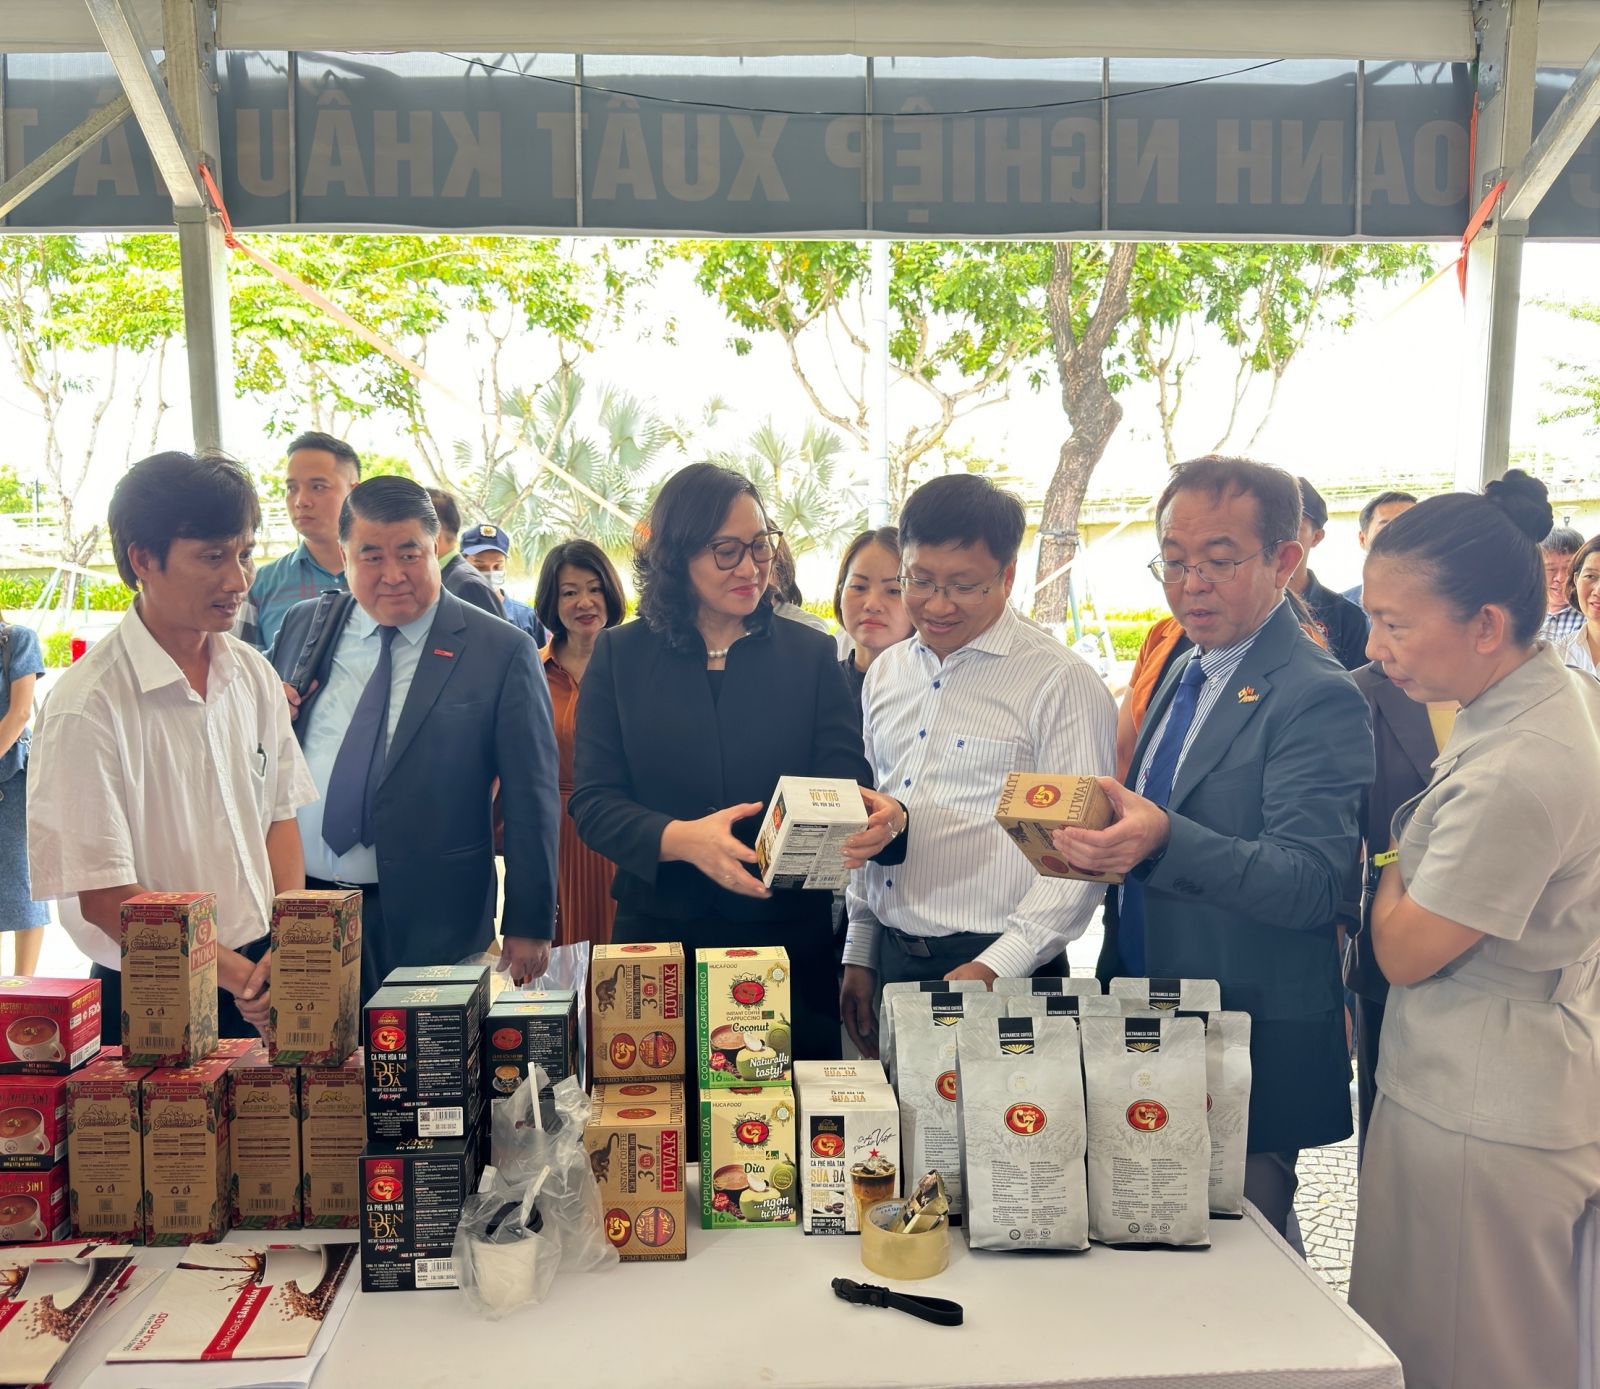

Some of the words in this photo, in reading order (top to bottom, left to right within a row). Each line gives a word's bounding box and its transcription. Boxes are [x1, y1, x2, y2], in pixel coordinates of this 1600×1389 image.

[998, 773, 1020, 816] LUWAK
[1067, 777, 1091, 821] LUWAK
[645, 986, 654, 994] in
[665, 965, 678, 1018] LUWAK
[642, 998, 657, 1009] 3
[700, 971, 708, 1029] CAPPUCCINO
[732, 1022, 770, 1032] Coconut
[700, 1038, 709, 1081] COCONUT
[750, 1052, 790, 1068] Naturally
[711, 1072, 723, 1082] 16
[755, 1065, 784, 1078] tasty!
[620, 1133, 628, 1160] COFFEE
[637, 1143, 653, 1151] 1
[643, 1156, 651, 1165] in
[663, 1133, 676, 1189] LUWAK
[620, 1161, 628, 1193] INSTANT
[638, 1171, 655, 1183] 3
[703, 1150, 711, 1216] CAPPUCCINO
[832, 1167, 846, 1183] ĐÁ
[713, 1213, 725, 1223] 16
[772, 1206, 794, 1218] nhiên
[132, 1312, 169, 1351] HUCAFOOD
[216, 1317, 244, 1351] CATALOGUE
